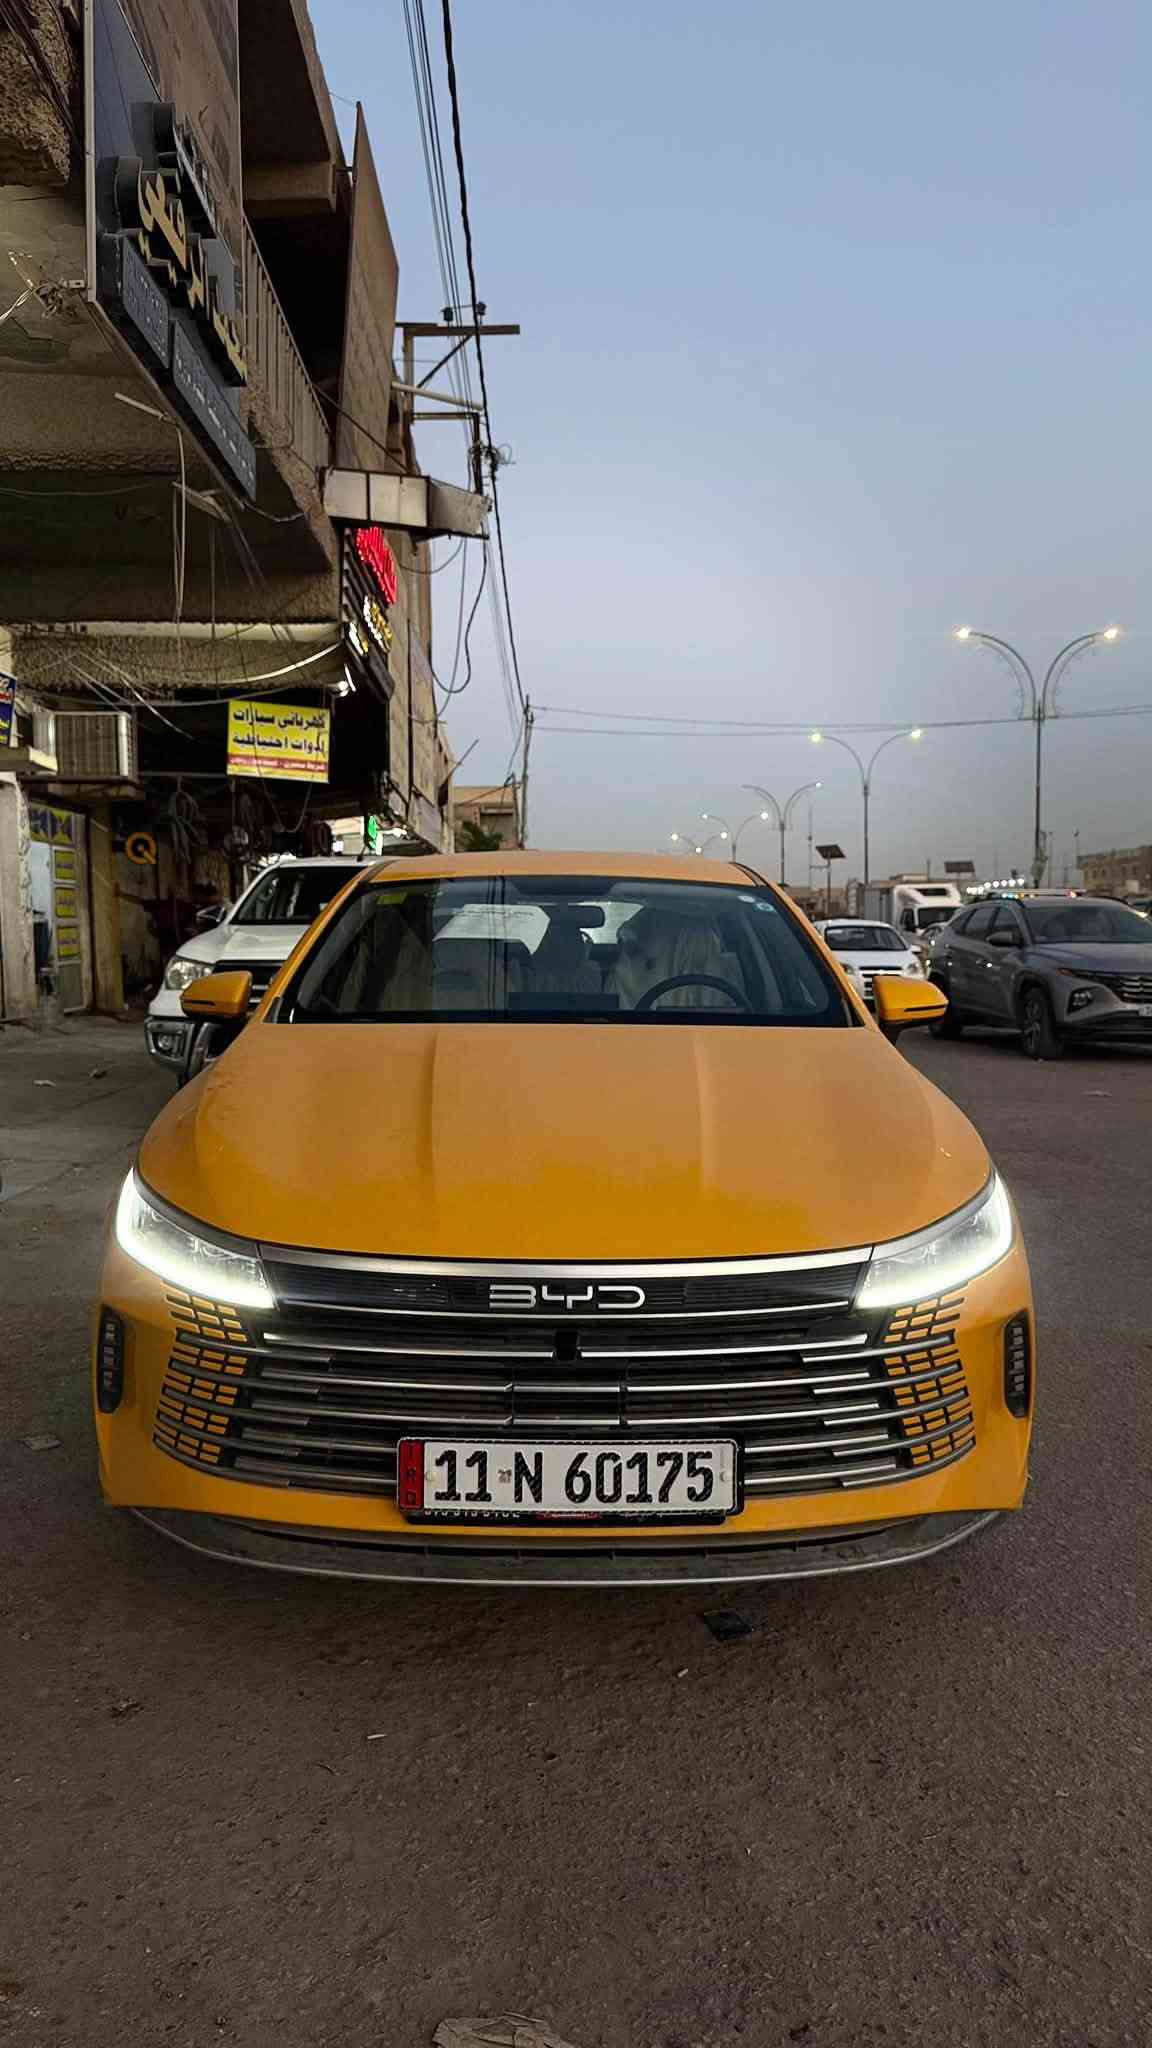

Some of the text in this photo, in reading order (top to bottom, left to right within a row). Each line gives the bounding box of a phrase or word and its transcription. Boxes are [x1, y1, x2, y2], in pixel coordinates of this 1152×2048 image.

[233, 708, 275, 727] سيارات
[233, 734, 288, 750] احتياطية
[489, 1285, 645, 1309] BYD
[435, 1450, 714, 1503] 11 N 60175
